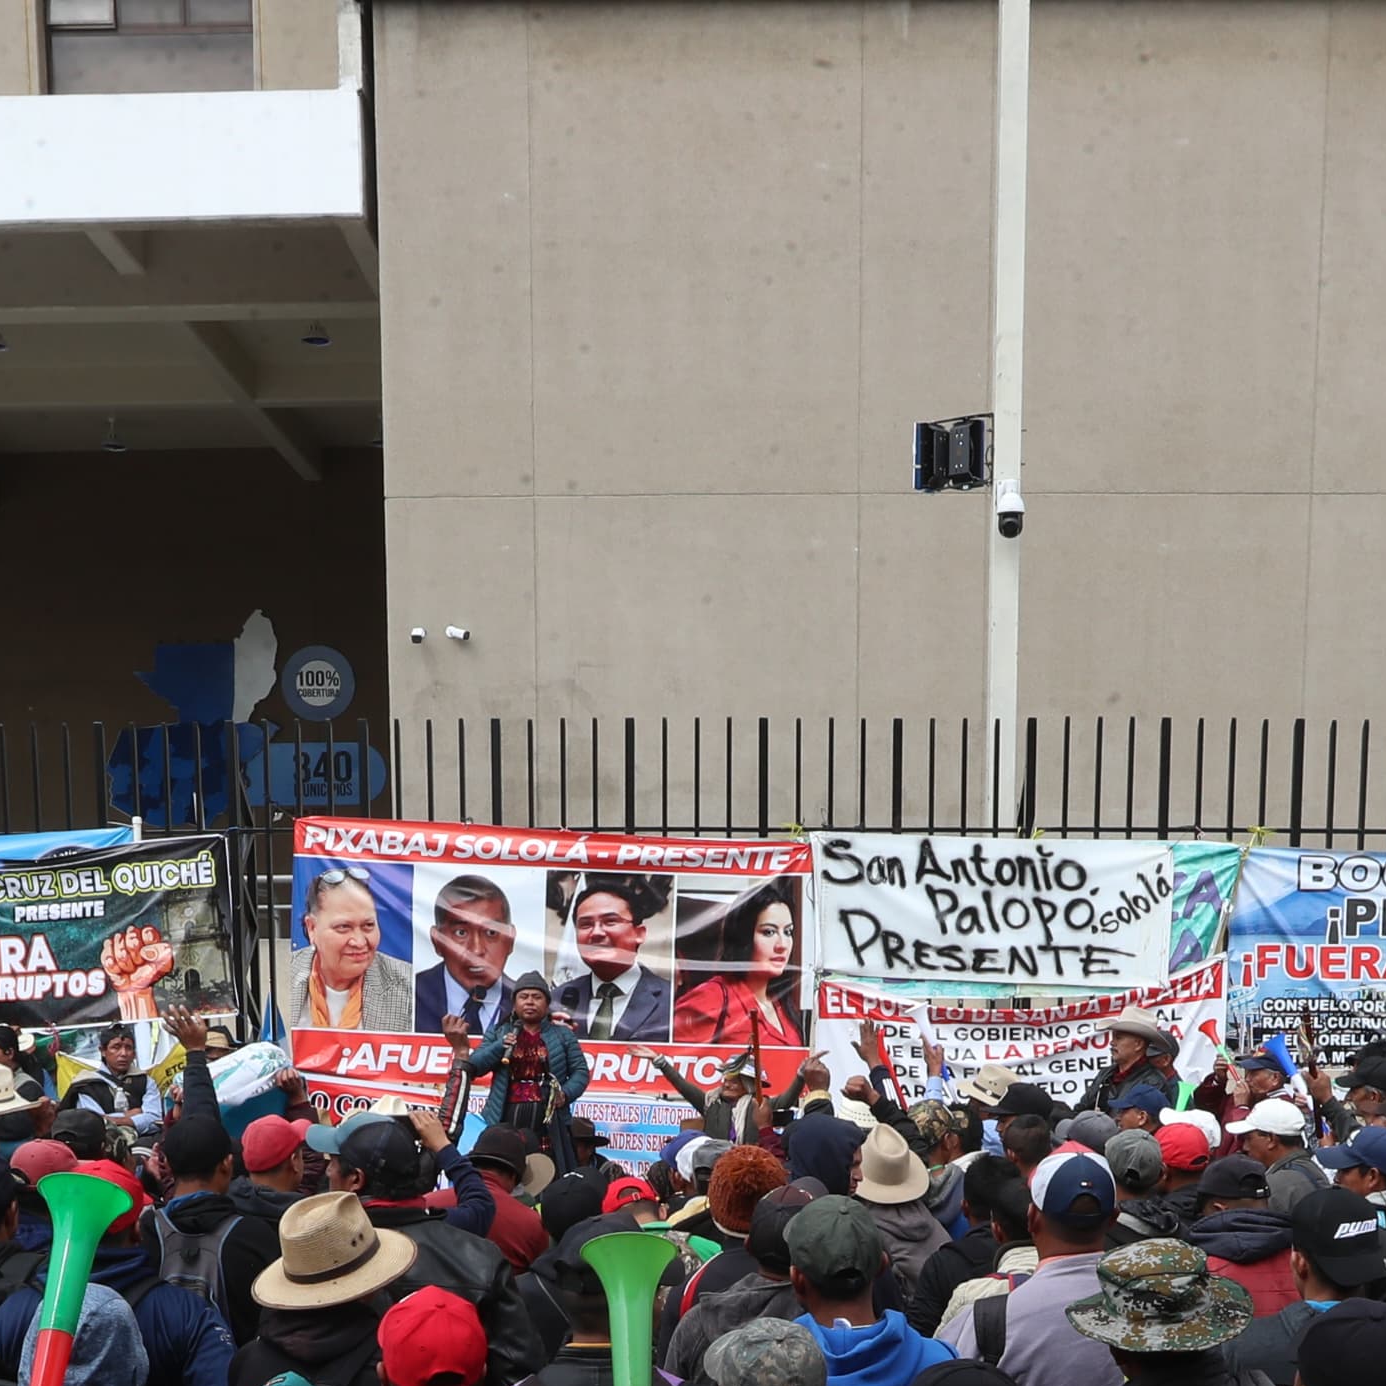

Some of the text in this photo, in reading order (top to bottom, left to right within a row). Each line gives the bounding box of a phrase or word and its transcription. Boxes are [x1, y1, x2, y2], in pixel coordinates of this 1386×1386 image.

[297, 671, 340, 687] 100%
[297, 688, 341, 698] COBERTURA
[293, 751, 352, 784] 340
[303, 825, 445, 858] PIXABAJ
[453, 835, 589, 864] SOLOLÁ
[617, 846, 792, 872] PRESENTE
[61, 869, 111, 896] DEL
[112, 850, 216, 895] QUICHÉ
[822, 839, 1087, 892] San Antonio
[14, 900, 106, 923] PRESENTE
[840, 908, 1135, 978] PRESENTE
[825, 988, 850, 1014] EL
[862, 994, 967, 1022] PUELO
[971, 1007, 1007, 1024] DE
[1014, 998, 1102, 1025] SANTA
[1263, 999, 1353, 1013] CONSUELO
[954, 1023, 1071, 1043] GOBIERNO
[985, 1043, 1024, 1061] LA
[1048, 1057, 1109, 1074] GENE
[573, 1102, 701, 1125] ANCESTRALES Y AUTORIDA
[607, 1133, 645, 1150] ANDRES
